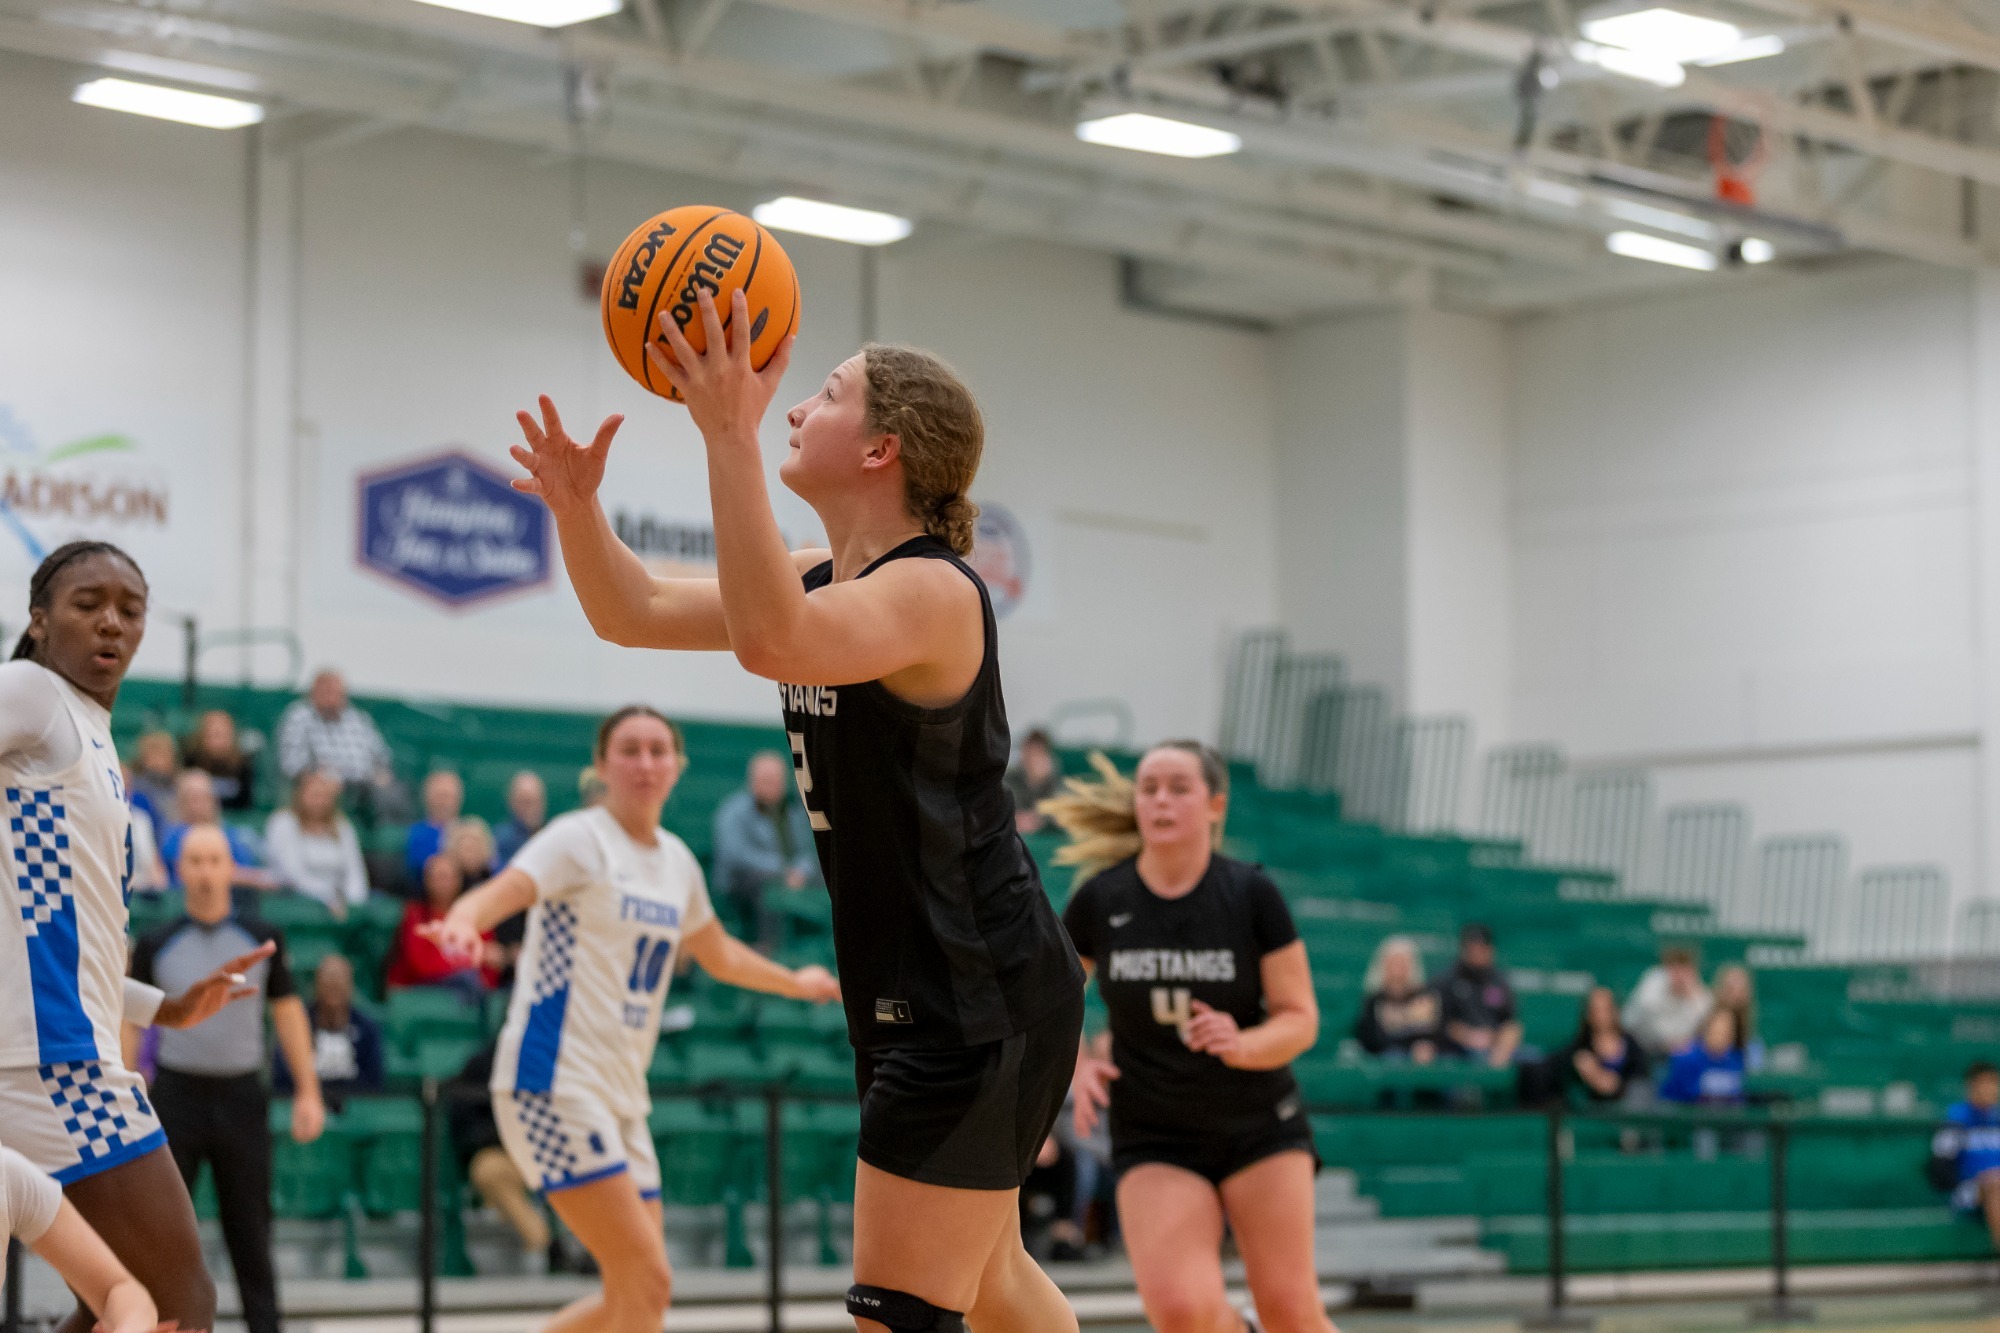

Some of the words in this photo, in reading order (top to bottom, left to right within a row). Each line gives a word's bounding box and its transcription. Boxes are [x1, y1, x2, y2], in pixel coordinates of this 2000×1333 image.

[618, 222, 678, 310] NCAA
[658, 232, 746, 344] Wilso
[628, 936, 670, 992] 10
[1109, 950, 1236, 982] MUSTANGS
[1151, 987, 1192, 1045] 4
